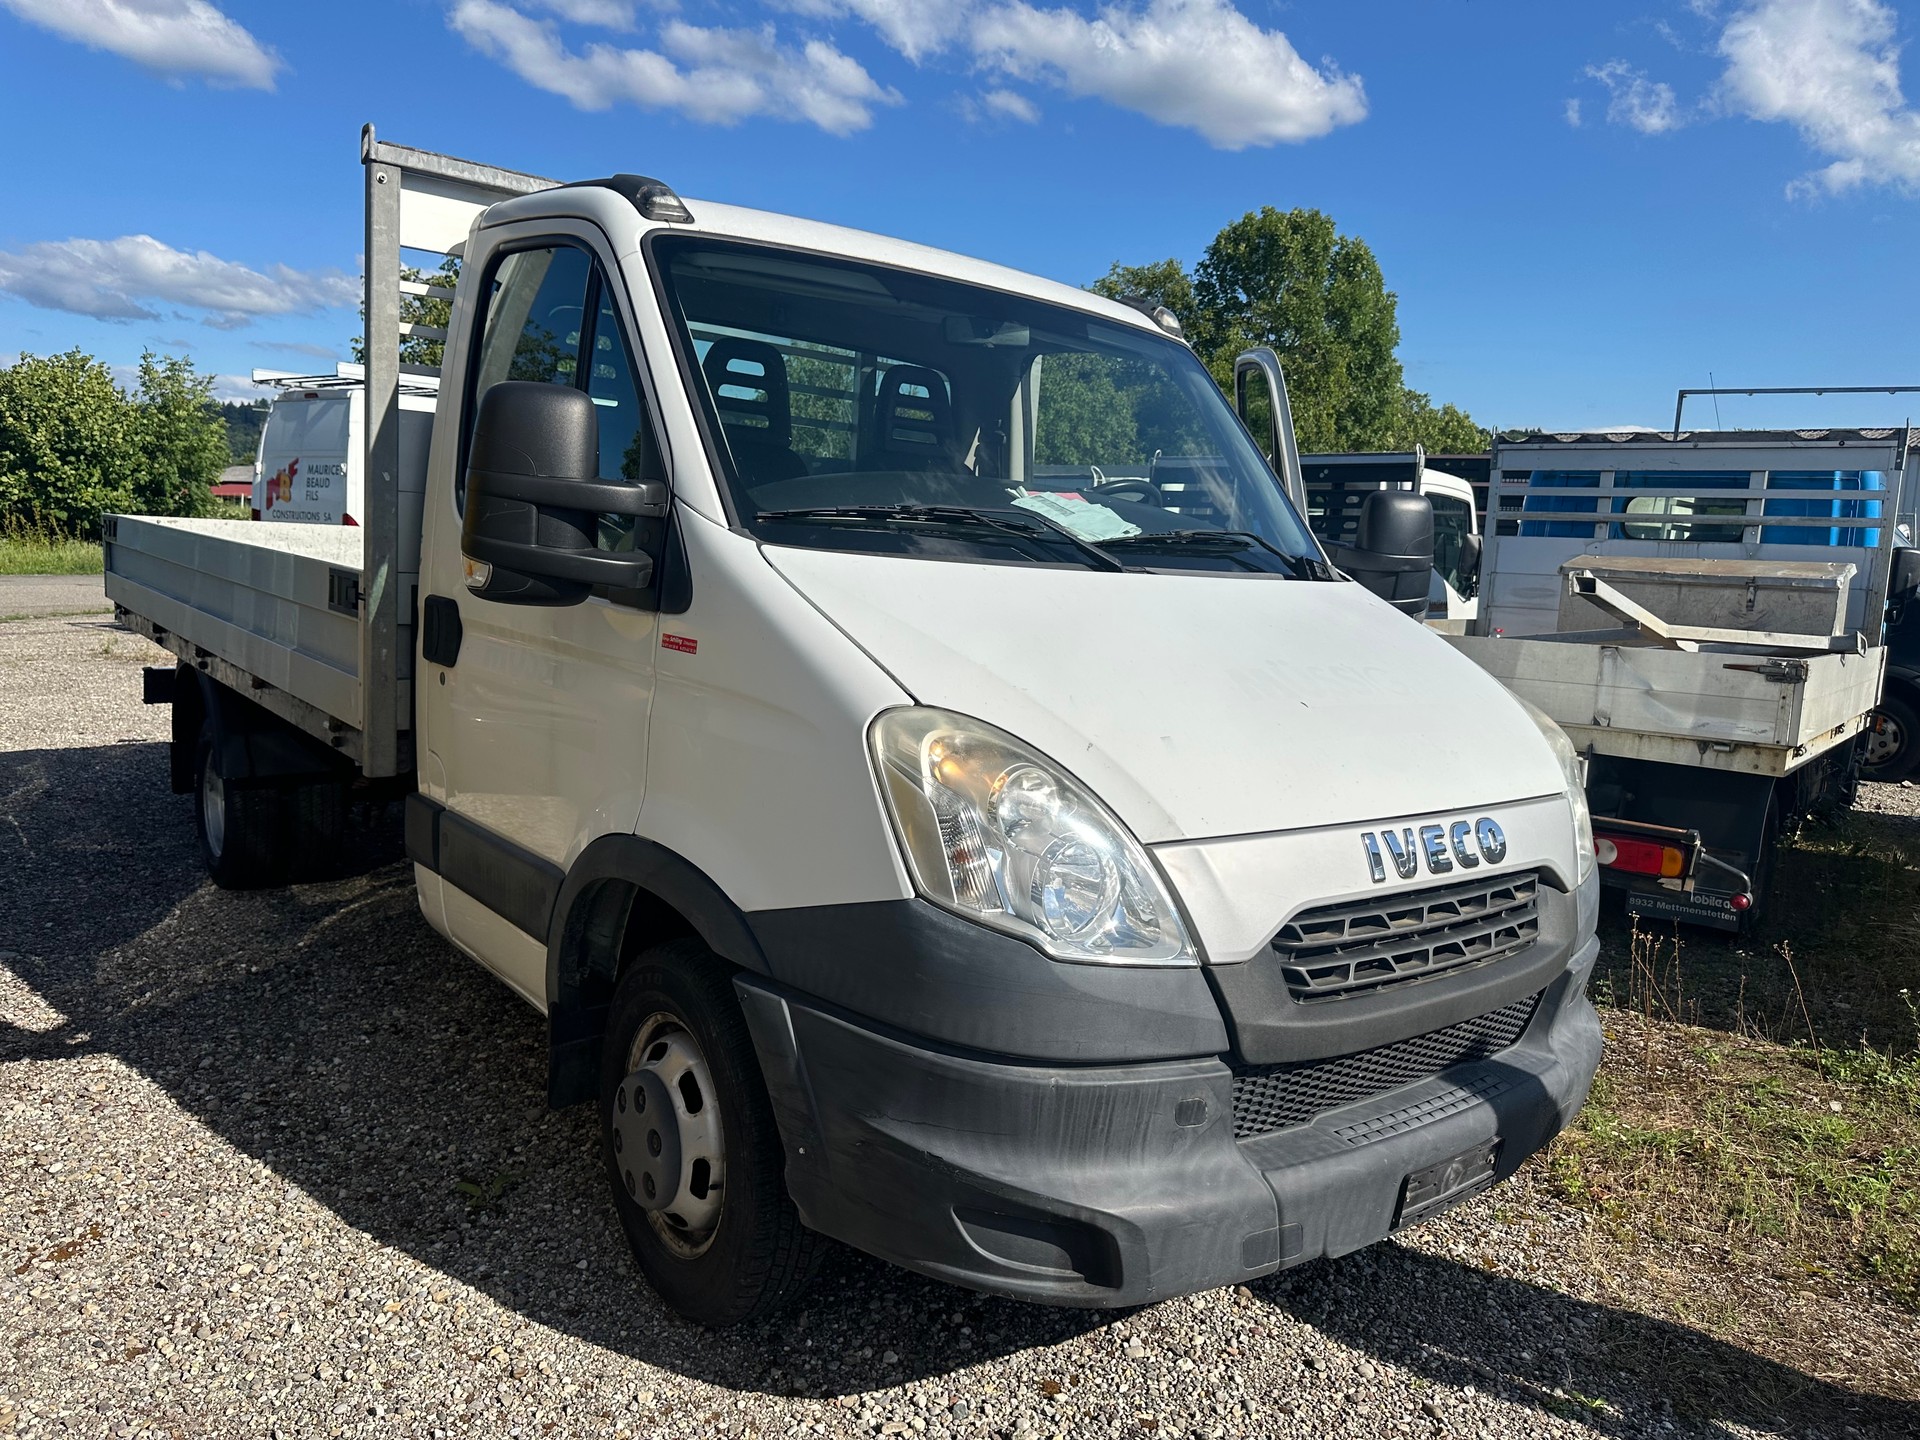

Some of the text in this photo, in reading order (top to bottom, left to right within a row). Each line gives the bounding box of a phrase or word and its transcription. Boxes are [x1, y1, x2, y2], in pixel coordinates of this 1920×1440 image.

[307, 464, 340, 475] MAURICE
[306, 477, 330, 488] BEAUD
[305, 490, 319, 501] FILS
[272, 510, 332, 521] CONSTRUCTIONS SA
[1361, 817, 1507, 883] IVECO
[1629, 897, 1737, 921] 8932 Mettmenstetten
